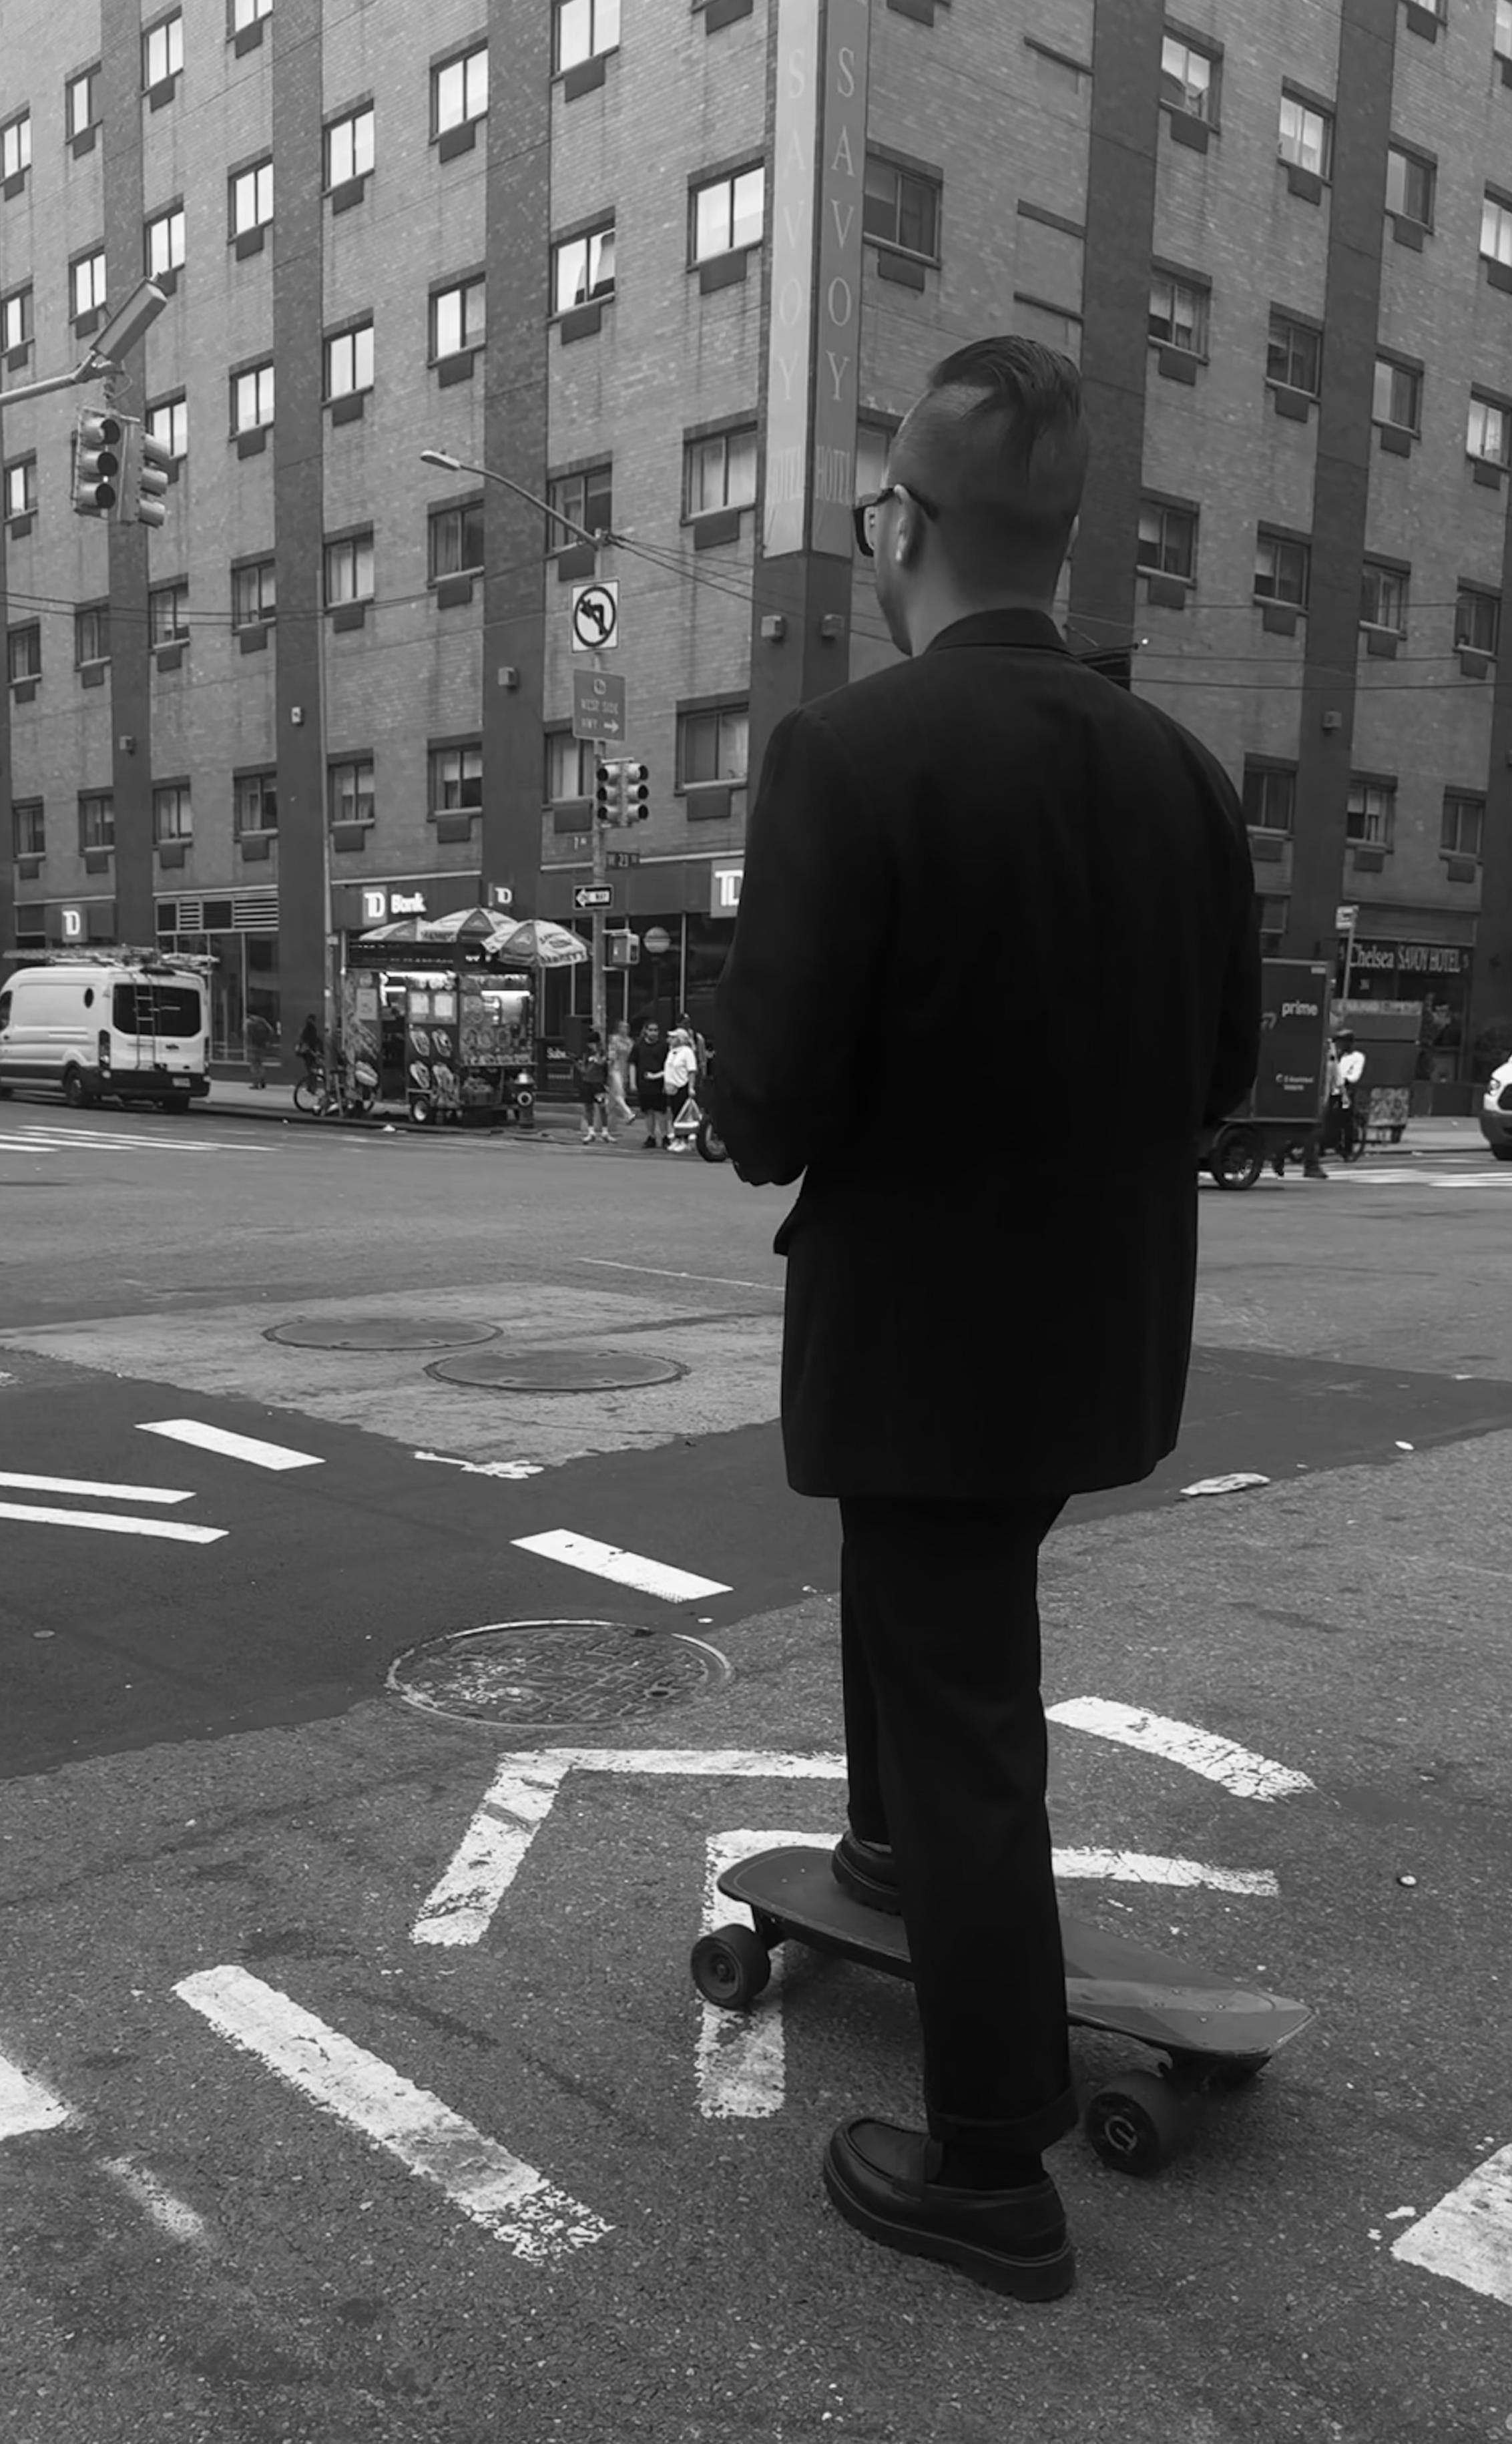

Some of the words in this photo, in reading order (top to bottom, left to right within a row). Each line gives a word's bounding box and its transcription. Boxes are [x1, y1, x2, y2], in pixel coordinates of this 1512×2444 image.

[778, 47, 806, 402] SAVOY
[826, 45, 856, 402] SAVOY
[363, 891, 386, 918] TD
[391, 892, 427, 915] Bank
[495, 887, 513, 905] TD
[62, 911, 81, 935] TD
[1350, 945, 1394, 968] Chelsea
[1397, 945, 1427, 971] SAVOY
[1429, 948, 1461, 973] HOTEL
[1282, 999, 1318, 1017] prime
